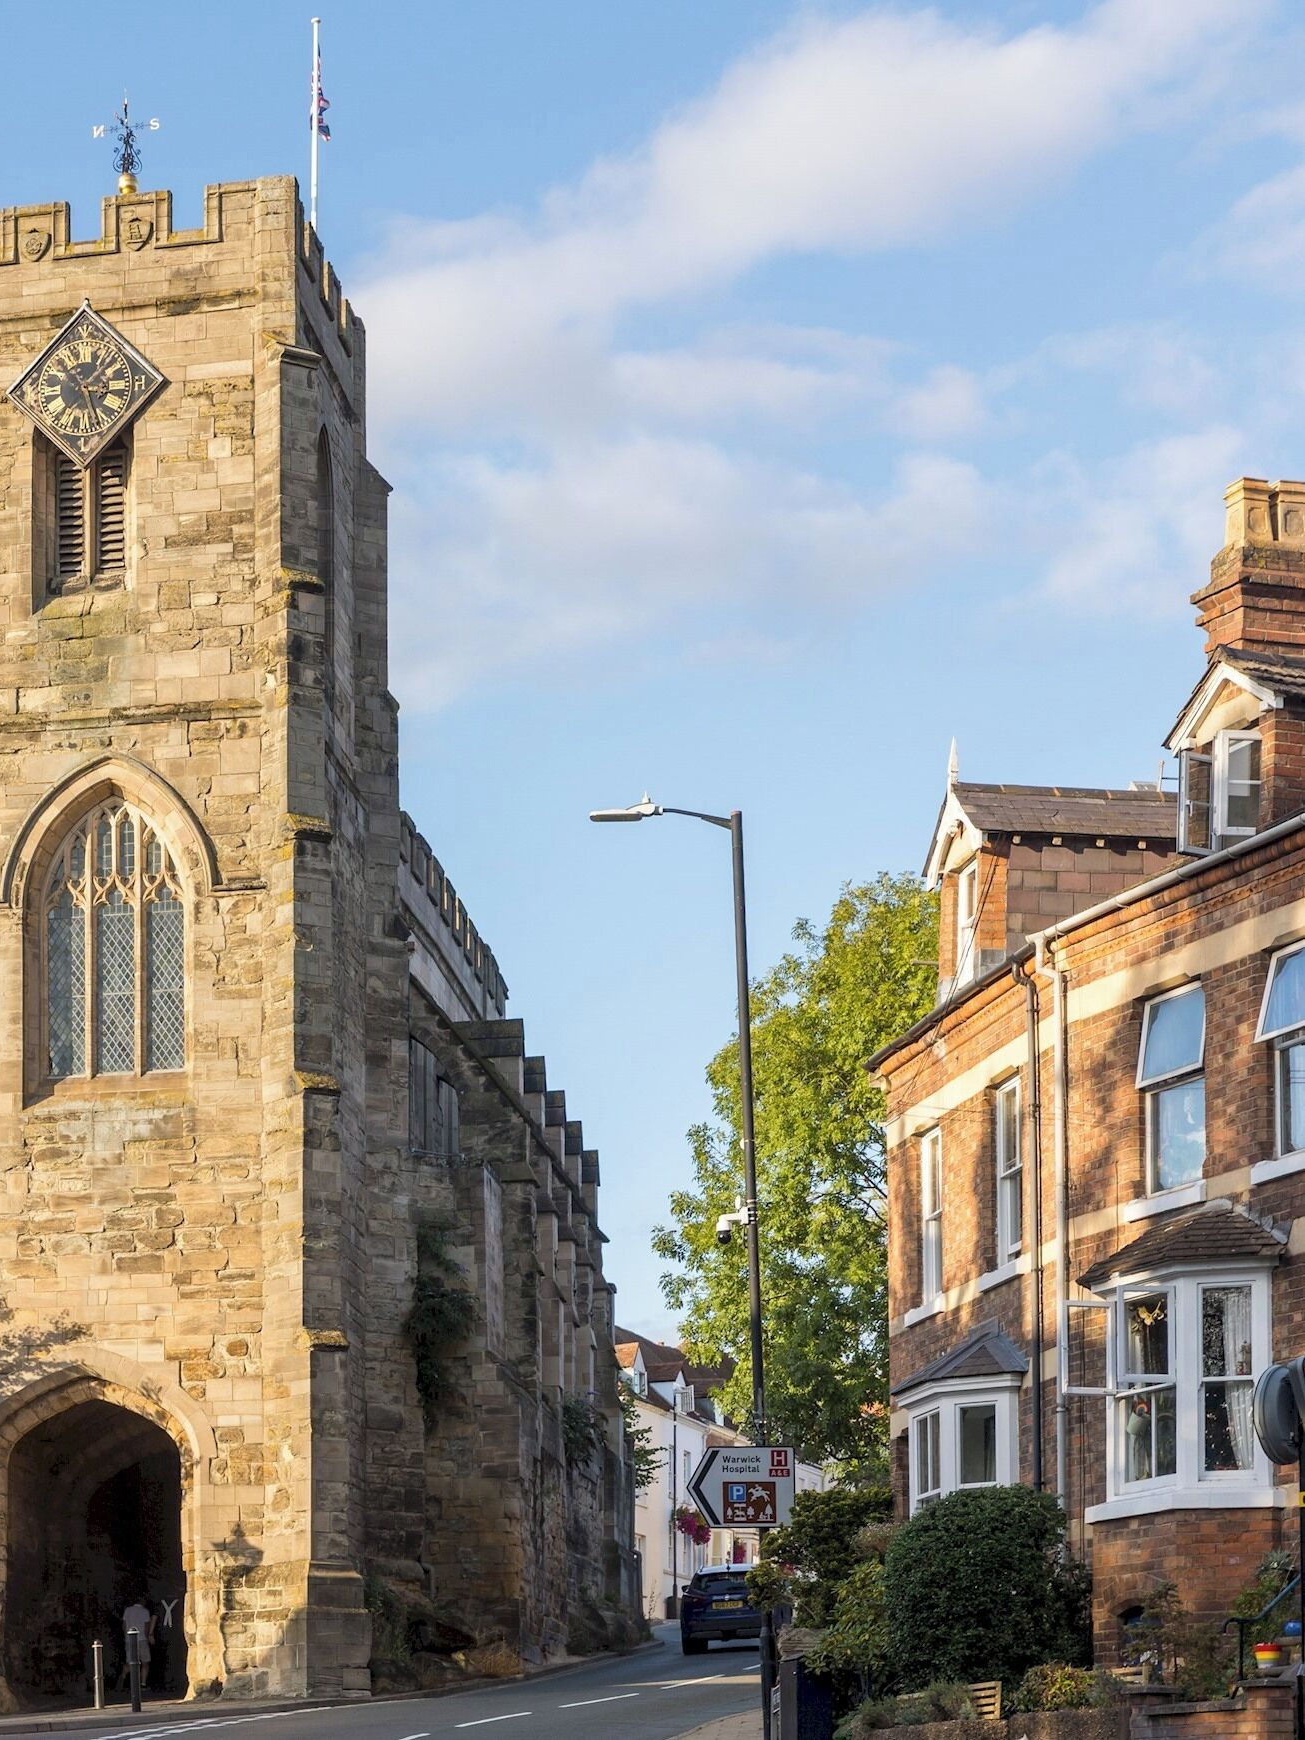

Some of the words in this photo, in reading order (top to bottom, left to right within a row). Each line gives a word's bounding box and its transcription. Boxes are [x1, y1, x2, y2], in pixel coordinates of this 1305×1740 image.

[150, 118, 160, 130] S
[78, 345, 92, 363] XII
[49, 367, 66, 381] X
[44, 384, 61, 396] IX
[108, 380, 126, 391] III
[134, 375, 146, 391] H
[47, 395, 66, 417] VIII
[60, 408, 75, 427] VII
[79, 410, 90, 429] VI
[96, 407, 109, 424] V
[79, 437, 90, 452] L
[722, 1455, 761, 1463] Warwick
[773, 1451, 785, 1466] H
[722, 1465, 760, 1474] Hospital
[733, 1486, 743, 1500] P
